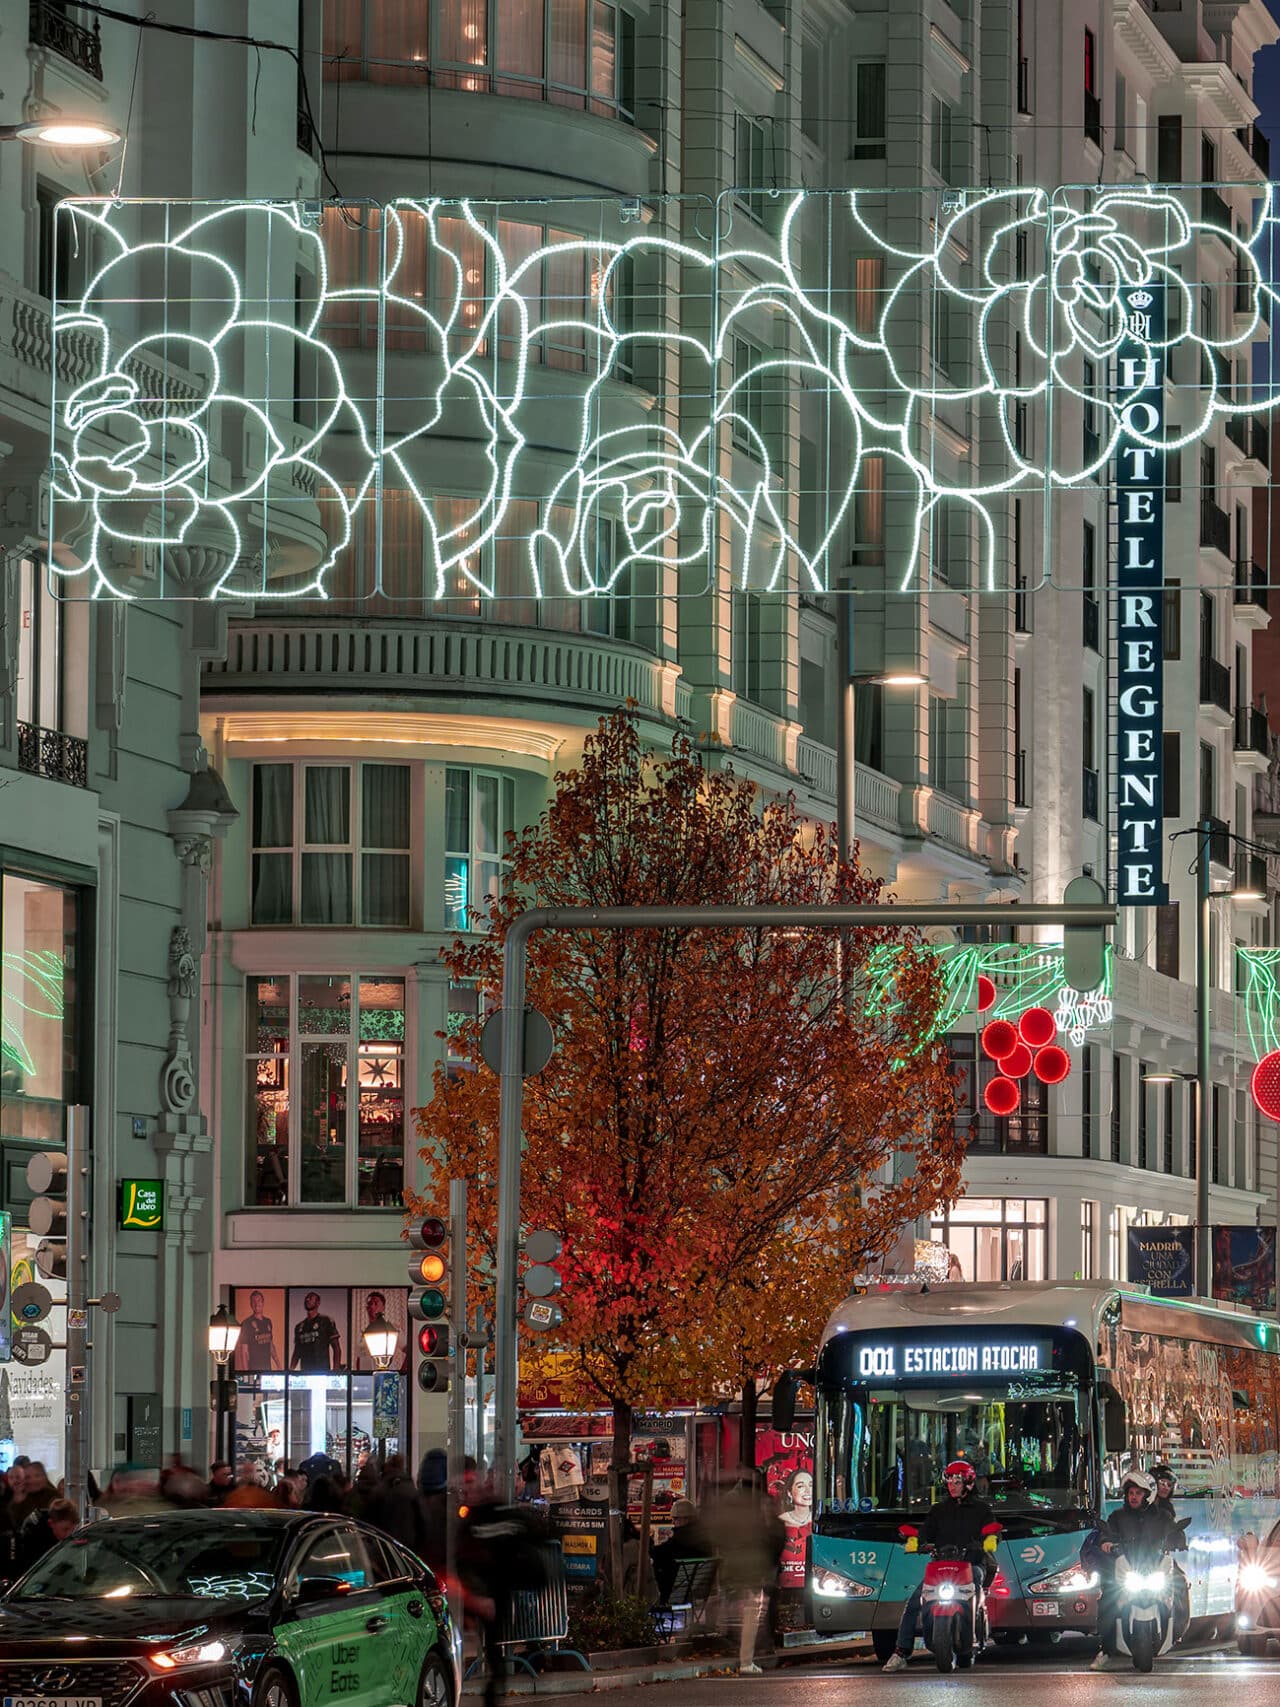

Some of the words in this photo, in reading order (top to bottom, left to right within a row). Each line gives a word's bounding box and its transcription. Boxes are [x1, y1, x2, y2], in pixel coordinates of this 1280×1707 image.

[1119, 357, 1161, 569] HOTEL
[1119, 595, 1159, 897] REGENTE
[137, 1189, 156, 1198] Casa
[136, 1202, 156, 1211] Libro
[1140, 1241, 1183, 1251] MADRID
[1151, 1251, 1174, 1260] UNA
[1147, 1270, 1172, 1279] CON
[859, 1347, 896, 1376] 001
[904, 1346, 978, 1372] ESTACION
[982, 1345, 1038, 1370] ATOCHA
[574, 1508, 603, 1516] CARDS
[850, 1551, 877, 1565] 132
[331, 1642, 360, 1665] Uber
[330, 1669, 360, 1693] Eats
